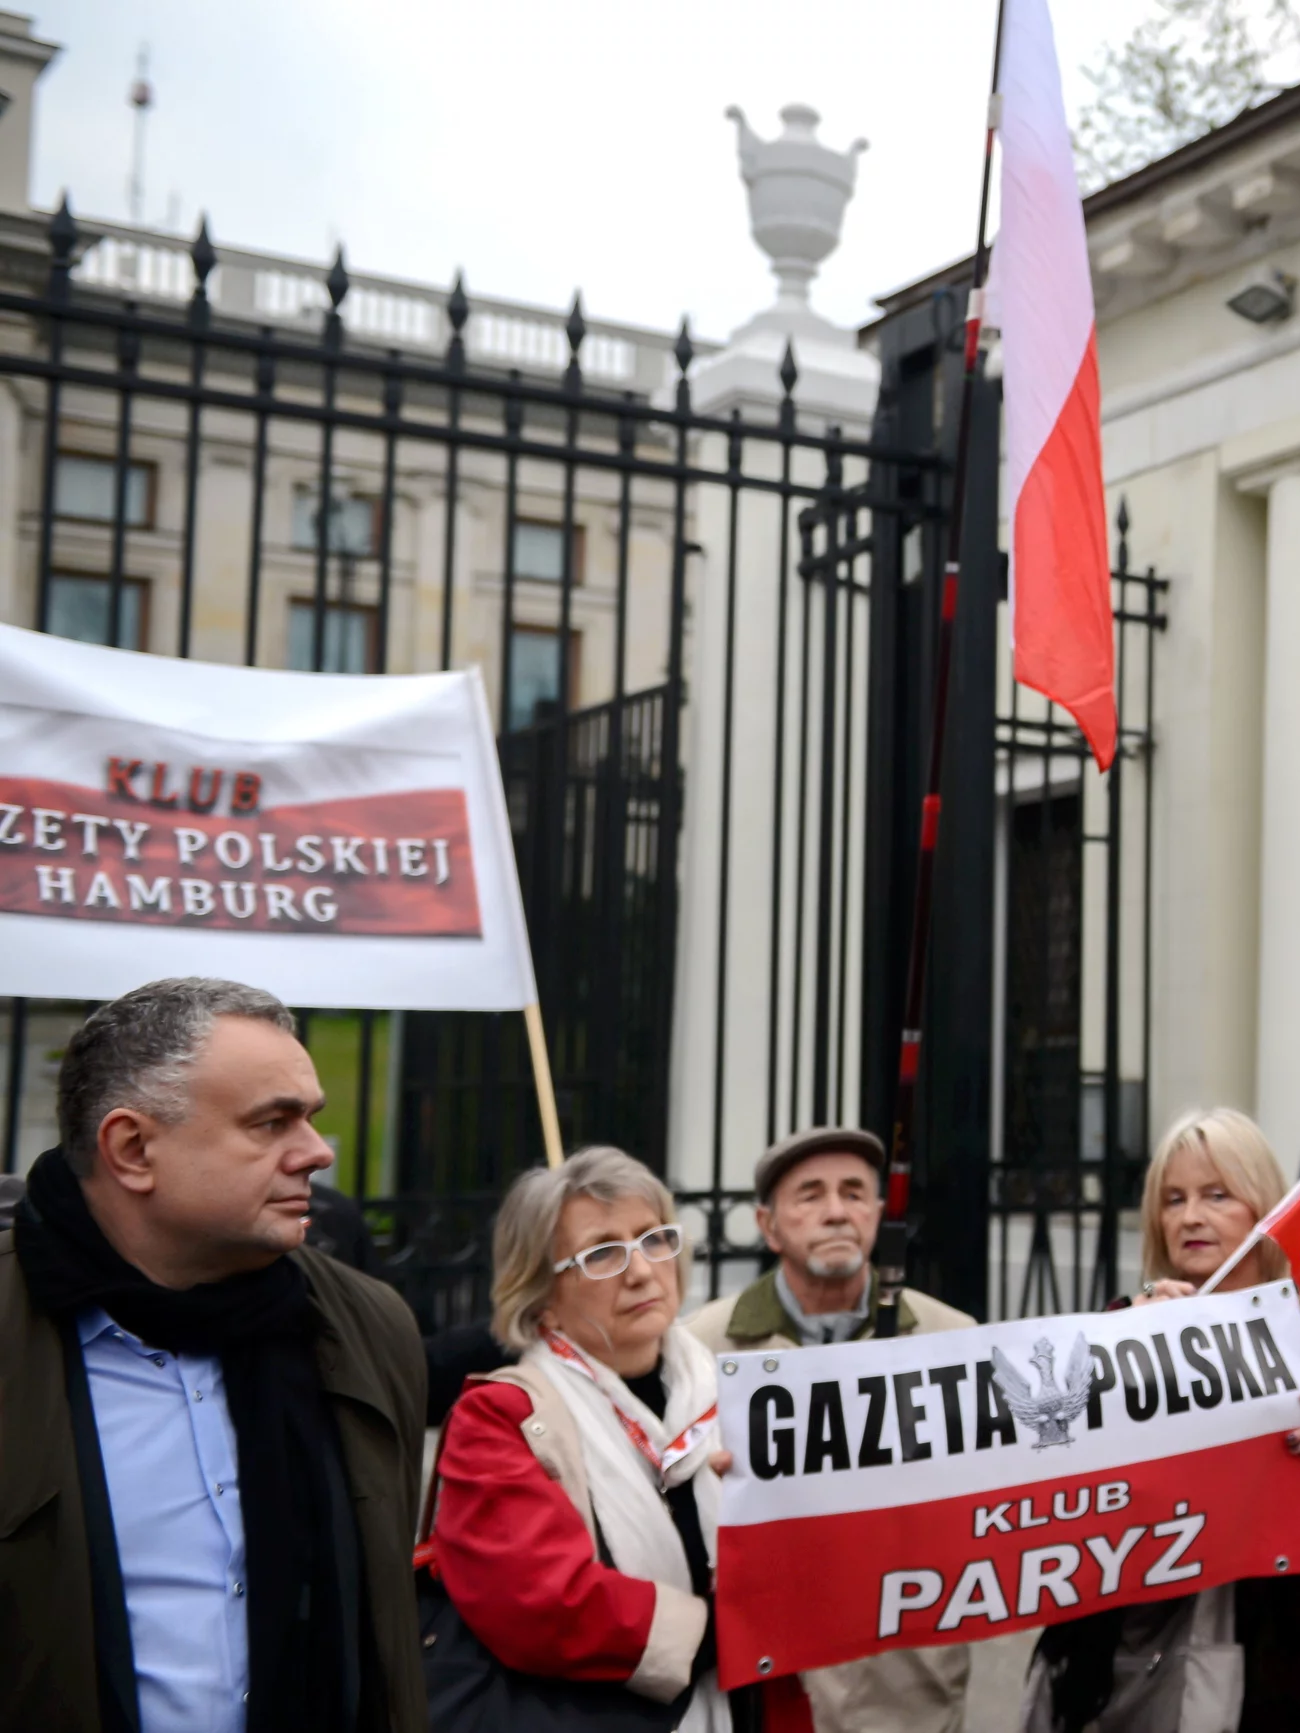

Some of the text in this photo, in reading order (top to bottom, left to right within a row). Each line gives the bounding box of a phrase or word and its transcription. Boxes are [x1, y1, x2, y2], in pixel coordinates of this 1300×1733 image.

[106, 756, 263, 813] KLUB
[175, 827, 450, 885] POLSKIEJ
[35, 864, 340, 923] HAMBURG
[748, 1360, 1018, 1480] GAZETA
[1087, 1317, 1298, 1430] POLSKA
[972, 1480, 1131, 1539] KLUB
[877, 1501, 1207, 1639] PARYŻ
